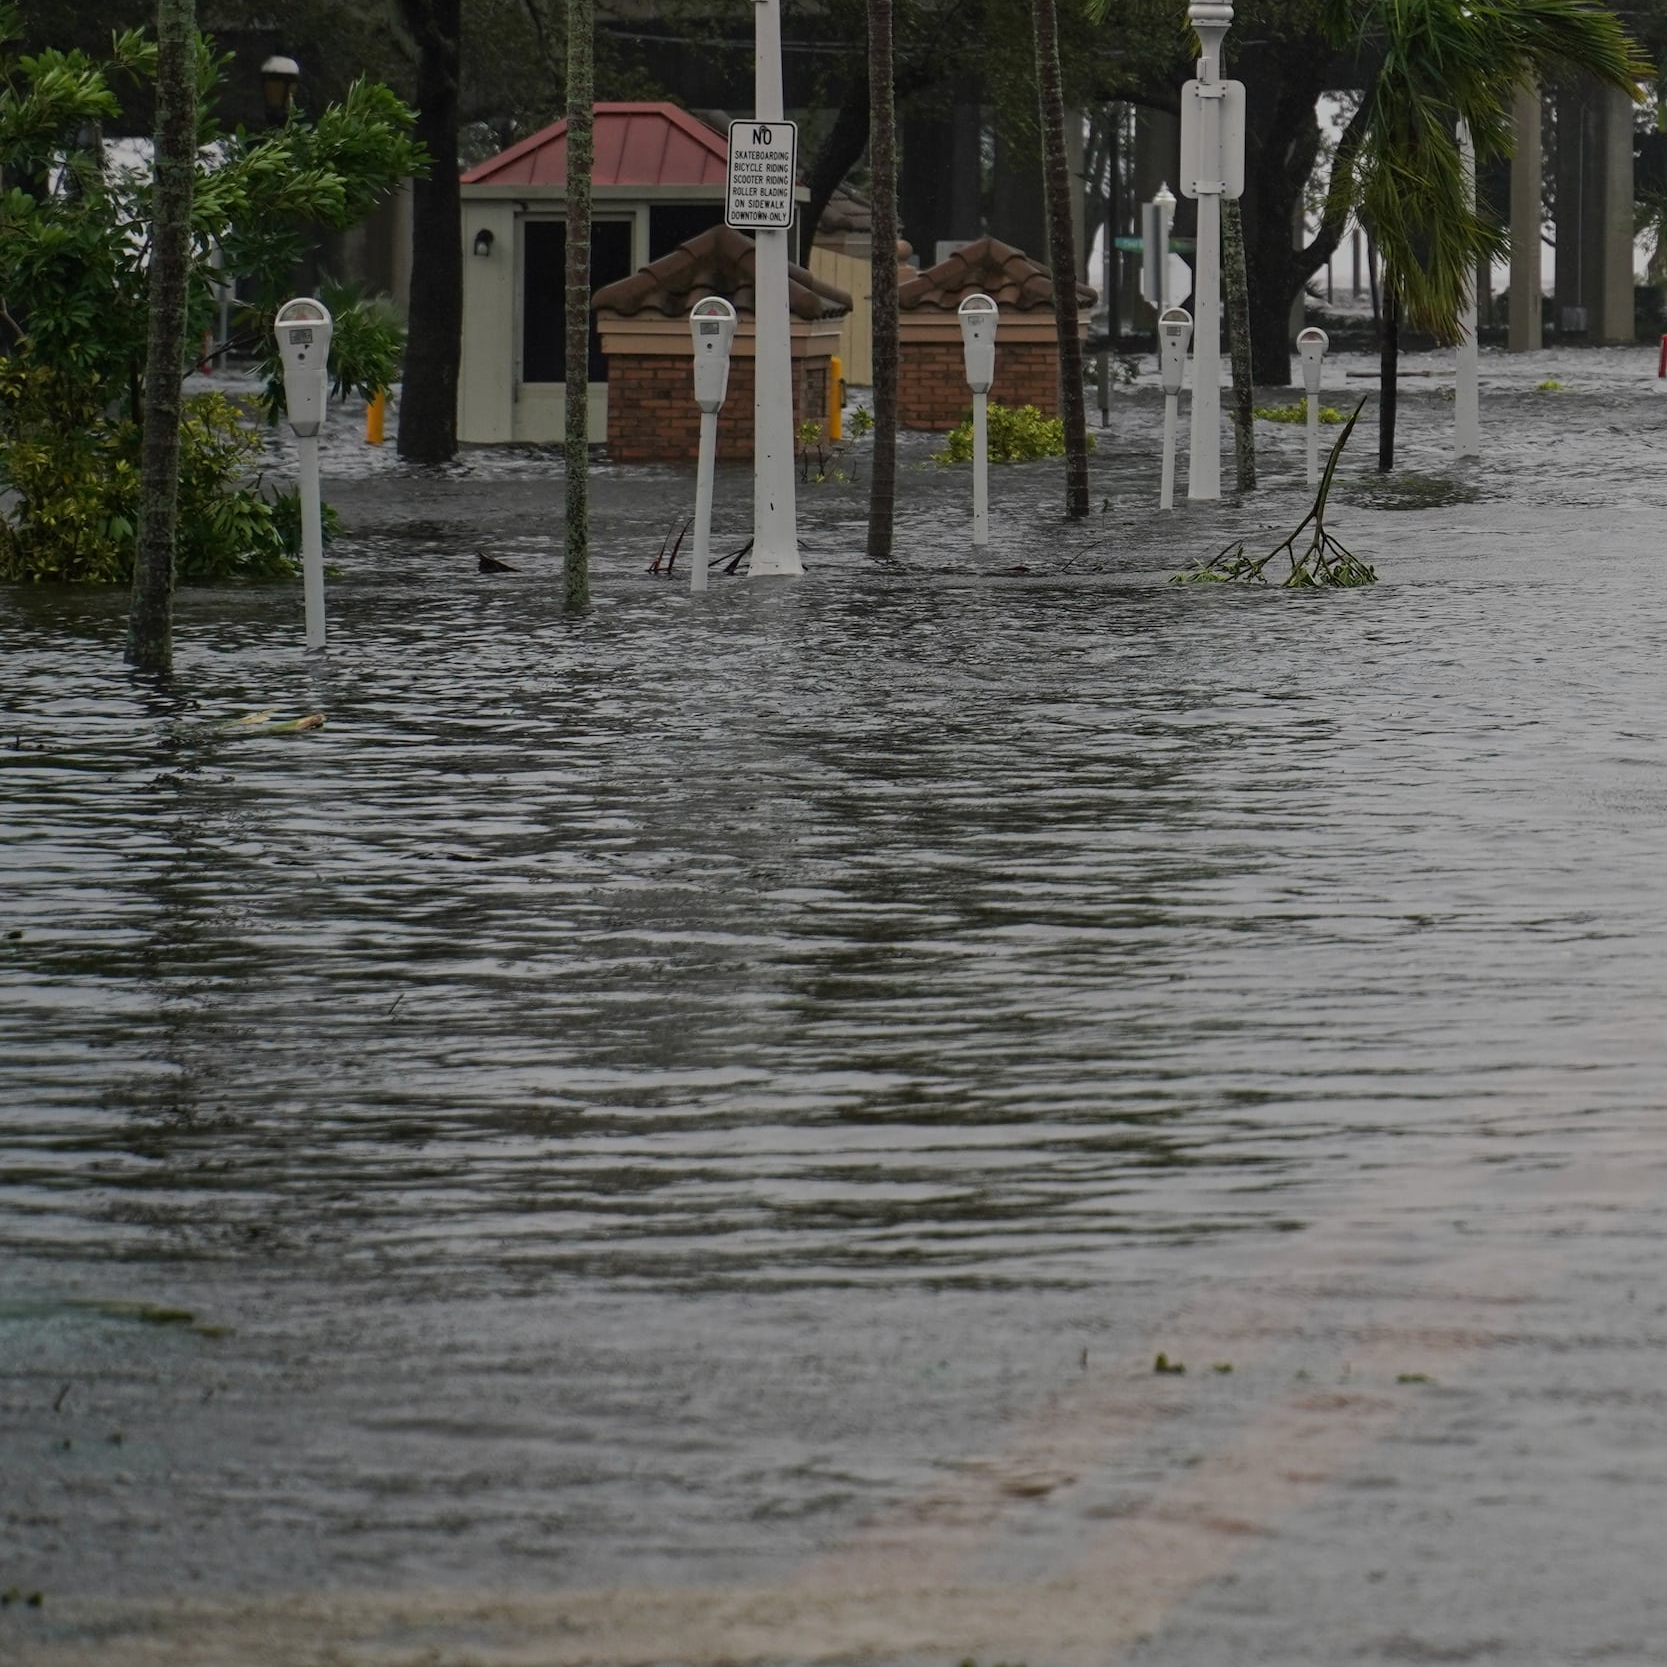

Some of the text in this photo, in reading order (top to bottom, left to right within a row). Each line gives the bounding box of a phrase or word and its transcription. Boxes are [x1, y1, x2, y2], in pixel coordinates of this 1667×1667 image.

[752, 128, 772, 145] NO
[734, 150, 789, 161] SKATEBOARDING
[734, 162, 789, 173] BICYCLE RIDING
[733, 175, 789, 185] SCOOTER RIDING
[732, 187, 788, 197] ROLLER BLADING
[734, 199, 785, 209] ON SIDEWALK
[769, 212, 787, 222] ONLY
